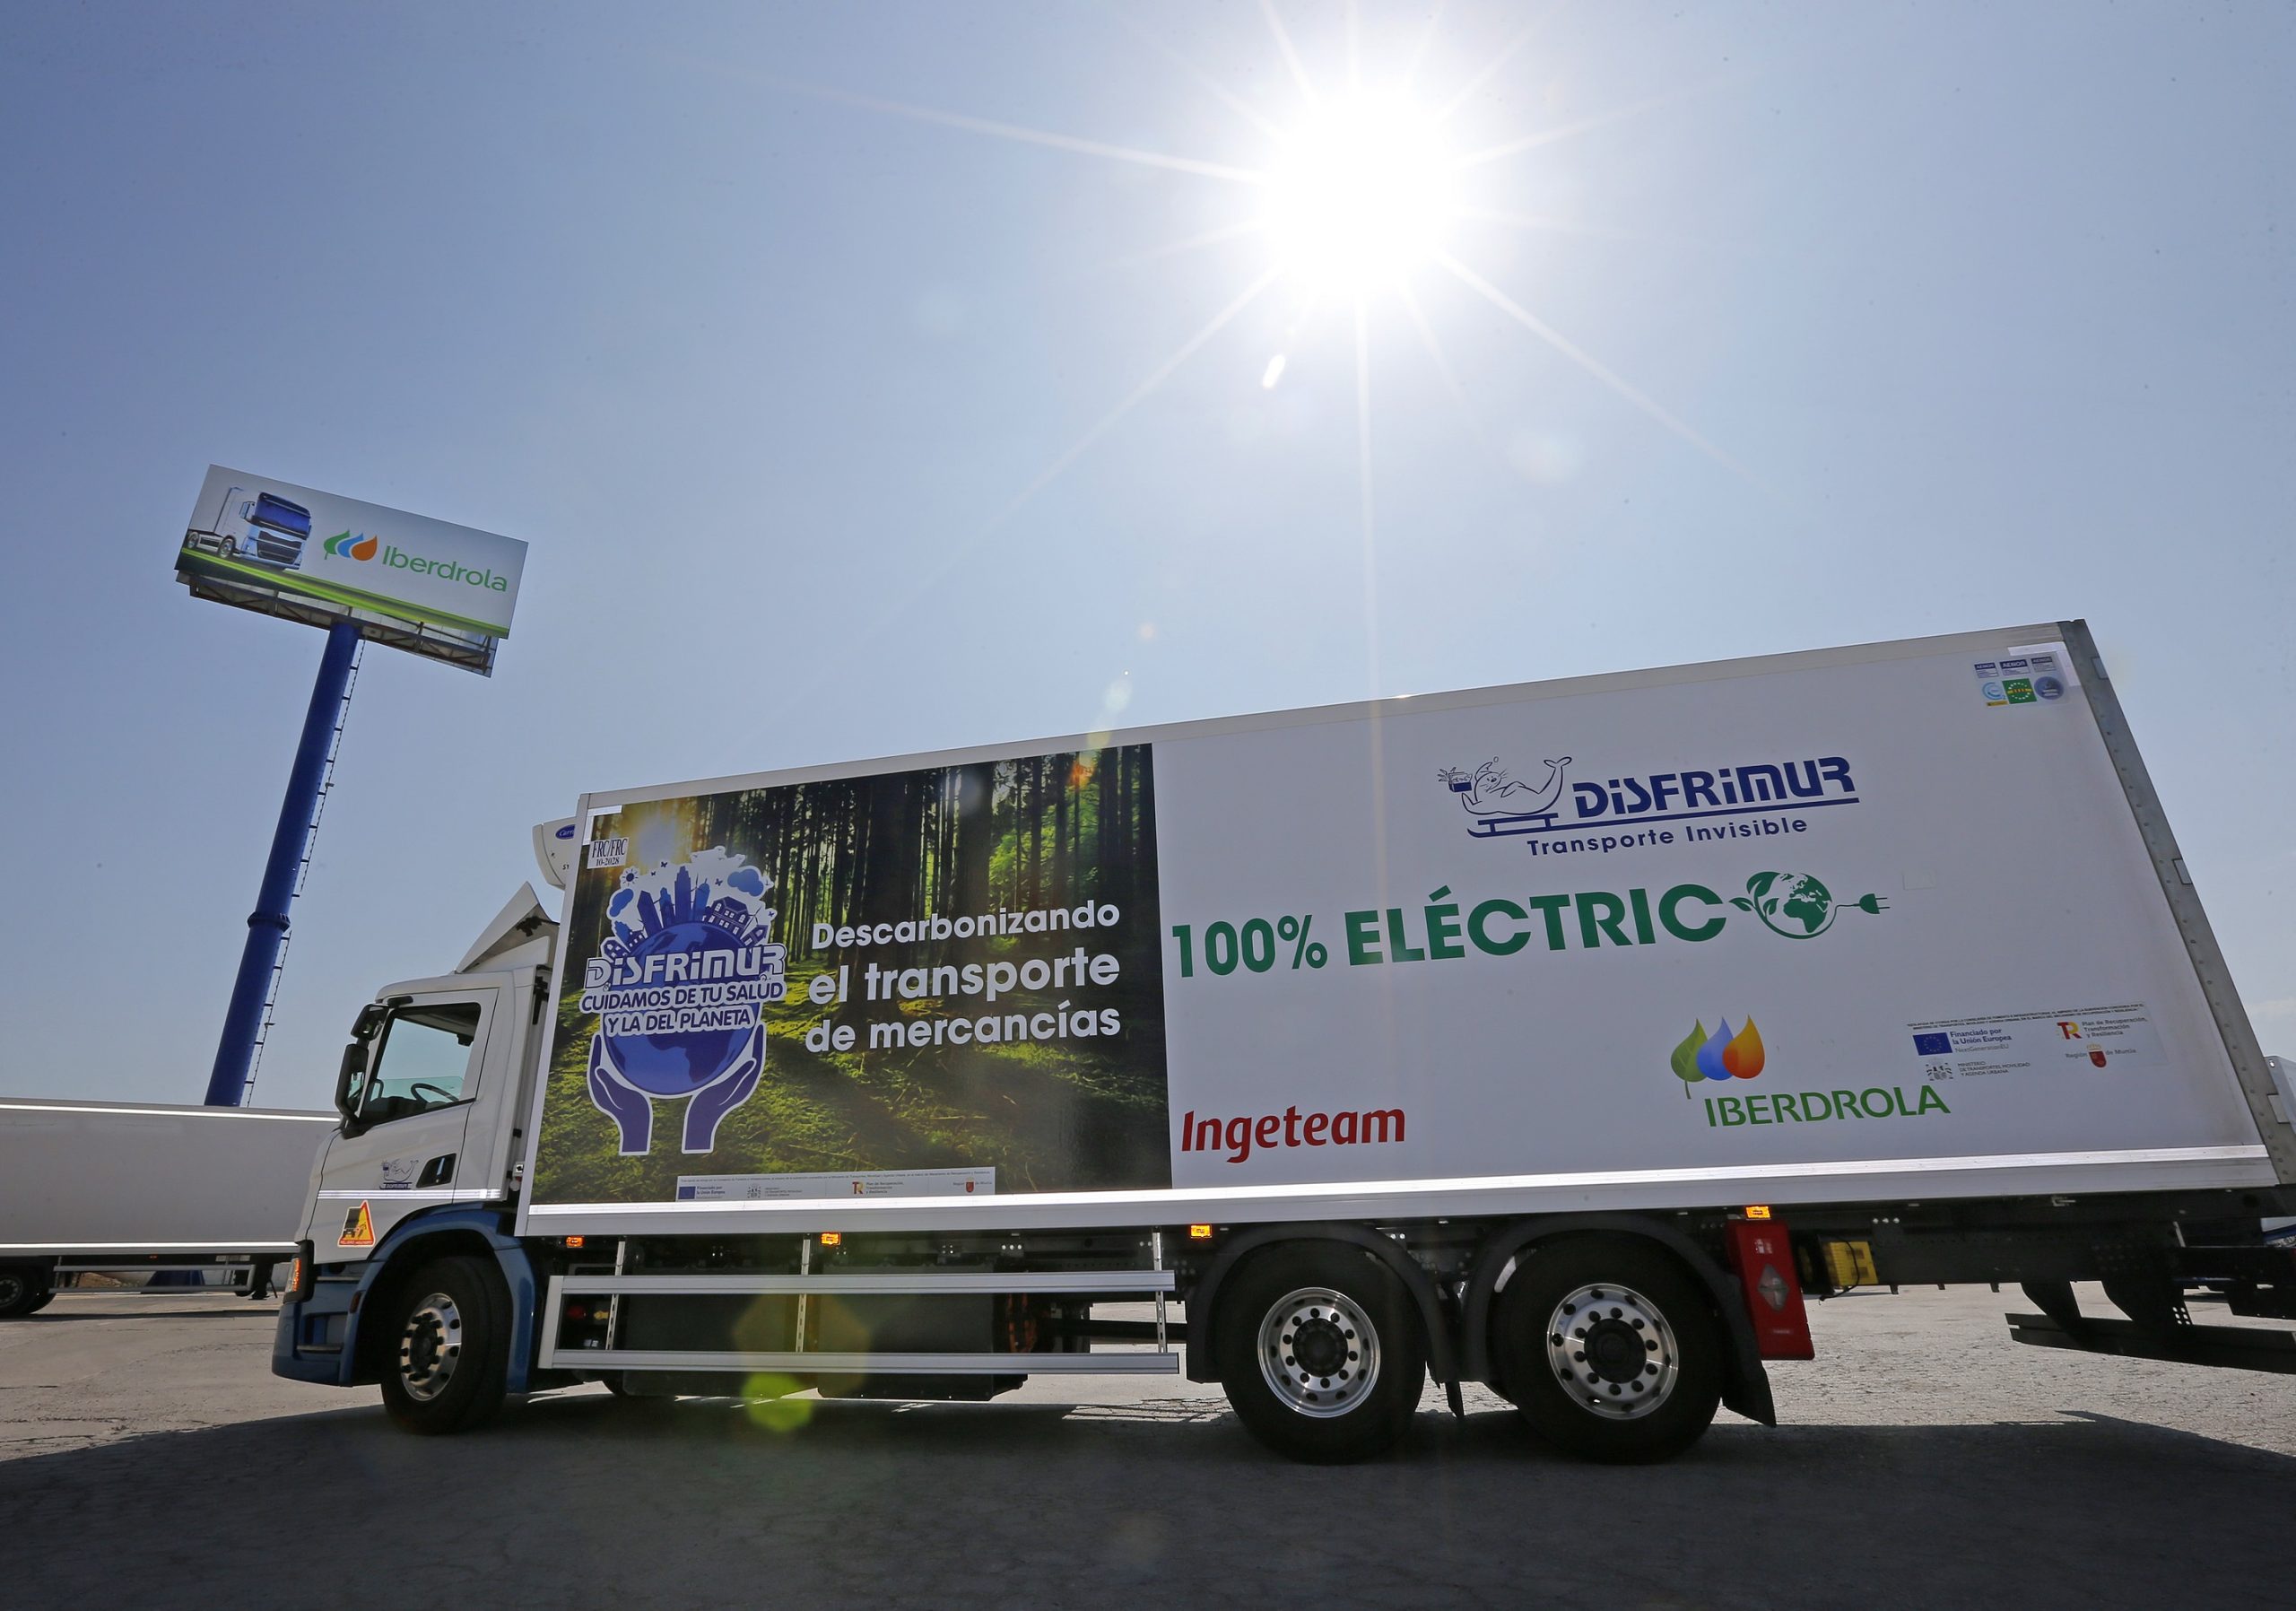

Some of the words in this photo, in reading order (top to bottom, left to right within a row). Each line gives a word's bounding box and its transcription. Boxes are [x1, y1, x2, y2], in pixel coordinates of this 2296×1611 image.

[382, 545, 508, 592] Iberdrola
[592, 838, 628, 858] FRC/FRC
[1526, 829, 1674, 856] Transporte
[1685, 816, 1808, 842] Invisible
[596, 858, 620, 866] 10-2028
[812, 900, 1120, 949] Descarbonizando
[1171, 914, 1328, 979] 100%
[582, 989, 670, 1011] CUIDAMOS
[675, 988, 696, 1004] DE
[700, 987, 722, 1003] TU
[726, 983, 783, 1002] SALUD
[808, 964, 848, 1005] el
[865, 947, 1120, 1002] transporte
[607, 1017, 619, 1032] Y
[622, 1014, 641, 1032] LA
[646, 1013, 674, 1031] DEL
[680, 1009, 751, 1029] PLANETA
[805, 1019, 856, 1053] de
[869, 999, 1121, 1049] mercancías
[1950, 1029, 1988, 1038] Financiado
[1989, 1028, 2002, 1036] por
[1960, 1036, 1982, 1045] Unión
[1982, 1035, 2013, 1043] Europea
[1704, 1084, 1951, 1128] IBERDROLA
[1181, 1105, 1405, 1163] Ingeteam
